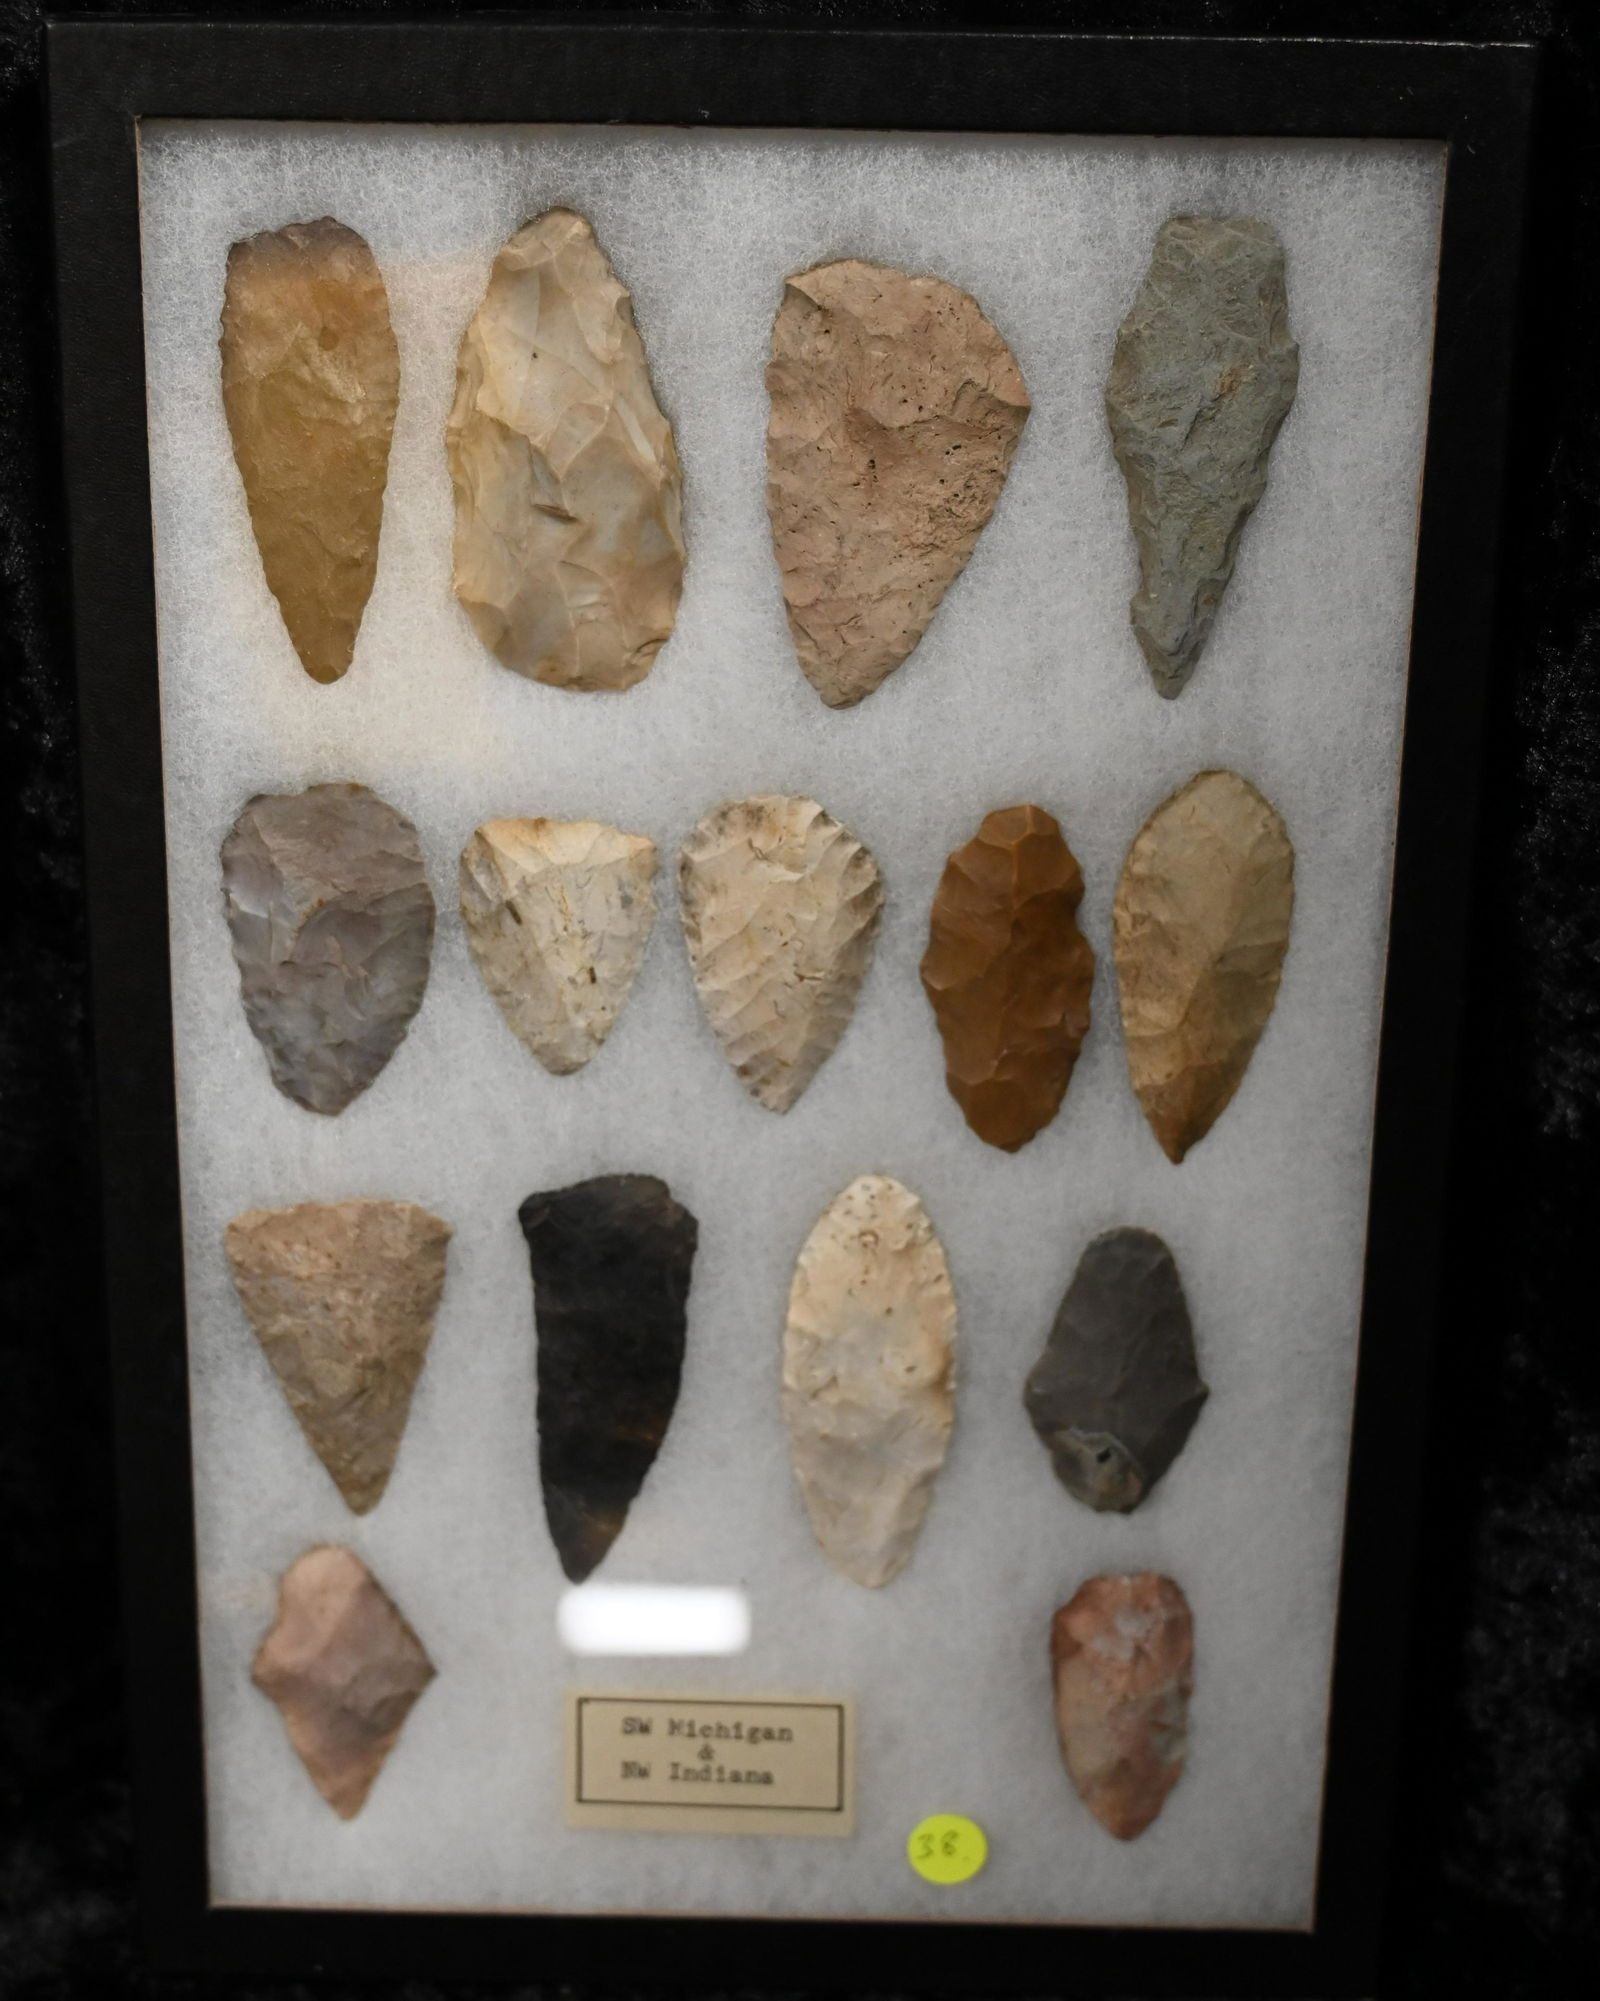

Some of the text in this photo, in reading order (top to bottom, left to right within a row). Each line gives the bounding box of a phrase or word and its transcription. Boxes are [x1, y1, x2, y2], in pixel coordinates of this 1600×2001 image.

[668, 1717, 794, 1744] Michigan
[698, 1743, 715, 1761] &
[669, 1761, 775, 1785] Indiana
